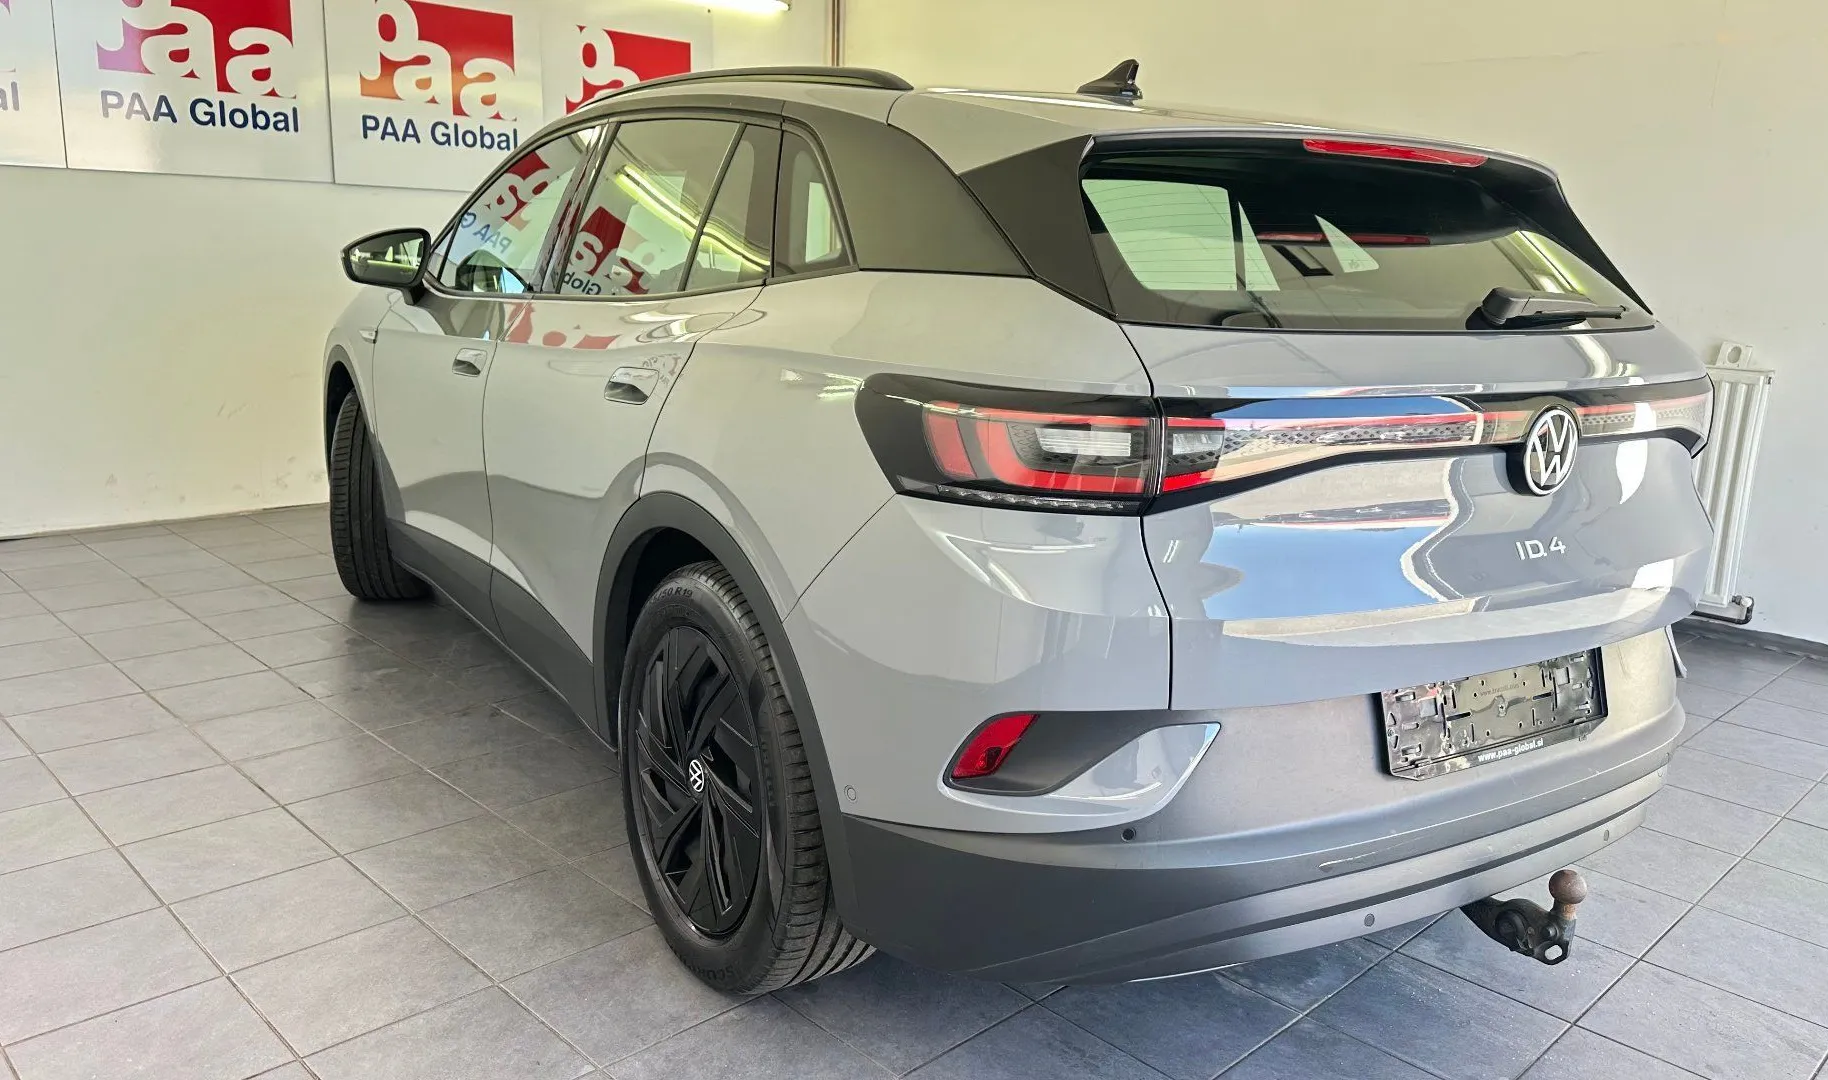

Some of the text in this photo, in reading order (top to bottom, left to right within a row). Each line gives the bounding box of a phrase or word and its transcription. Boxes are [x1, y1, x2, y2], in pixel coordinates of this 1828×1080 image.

[100, 89, 299, 133] PAA Global
[361, 114, 518, 151] PAA Global
[1477, 737, 1544, 762] www.paa-global.si
